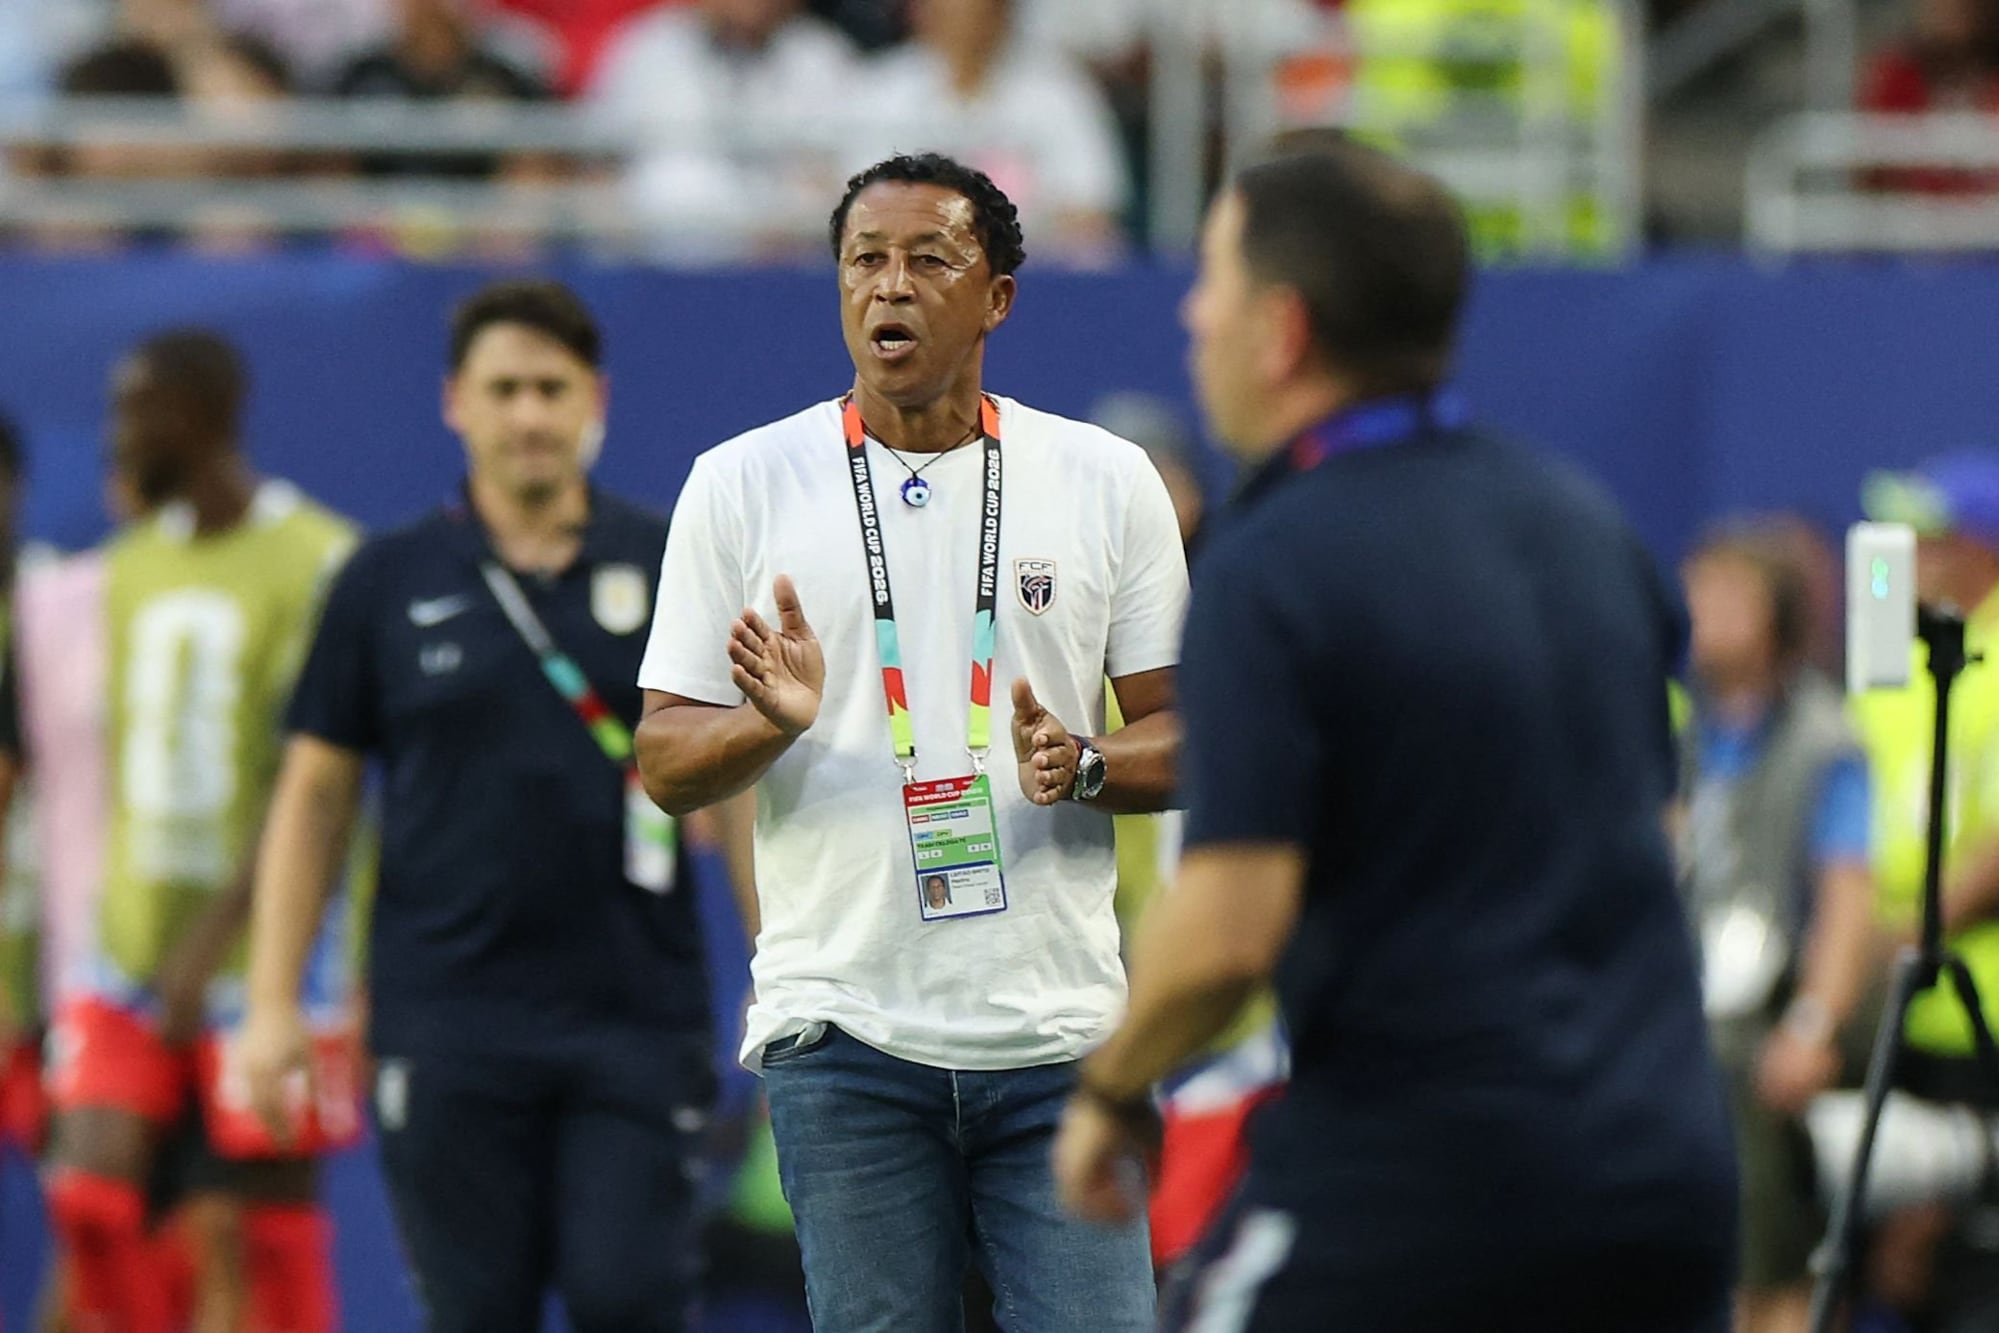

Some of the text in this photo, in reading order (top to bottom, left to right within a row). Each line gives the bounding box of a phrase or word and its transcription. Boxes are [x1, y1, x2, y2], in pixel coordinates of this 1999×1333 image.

[852, 456, 889, 605] FIFA WORLD CUP 2026
[981, 449, 1000, 596] FIFA WORLD CUP 2026
[1019, 561, 1052, 570] FCF
